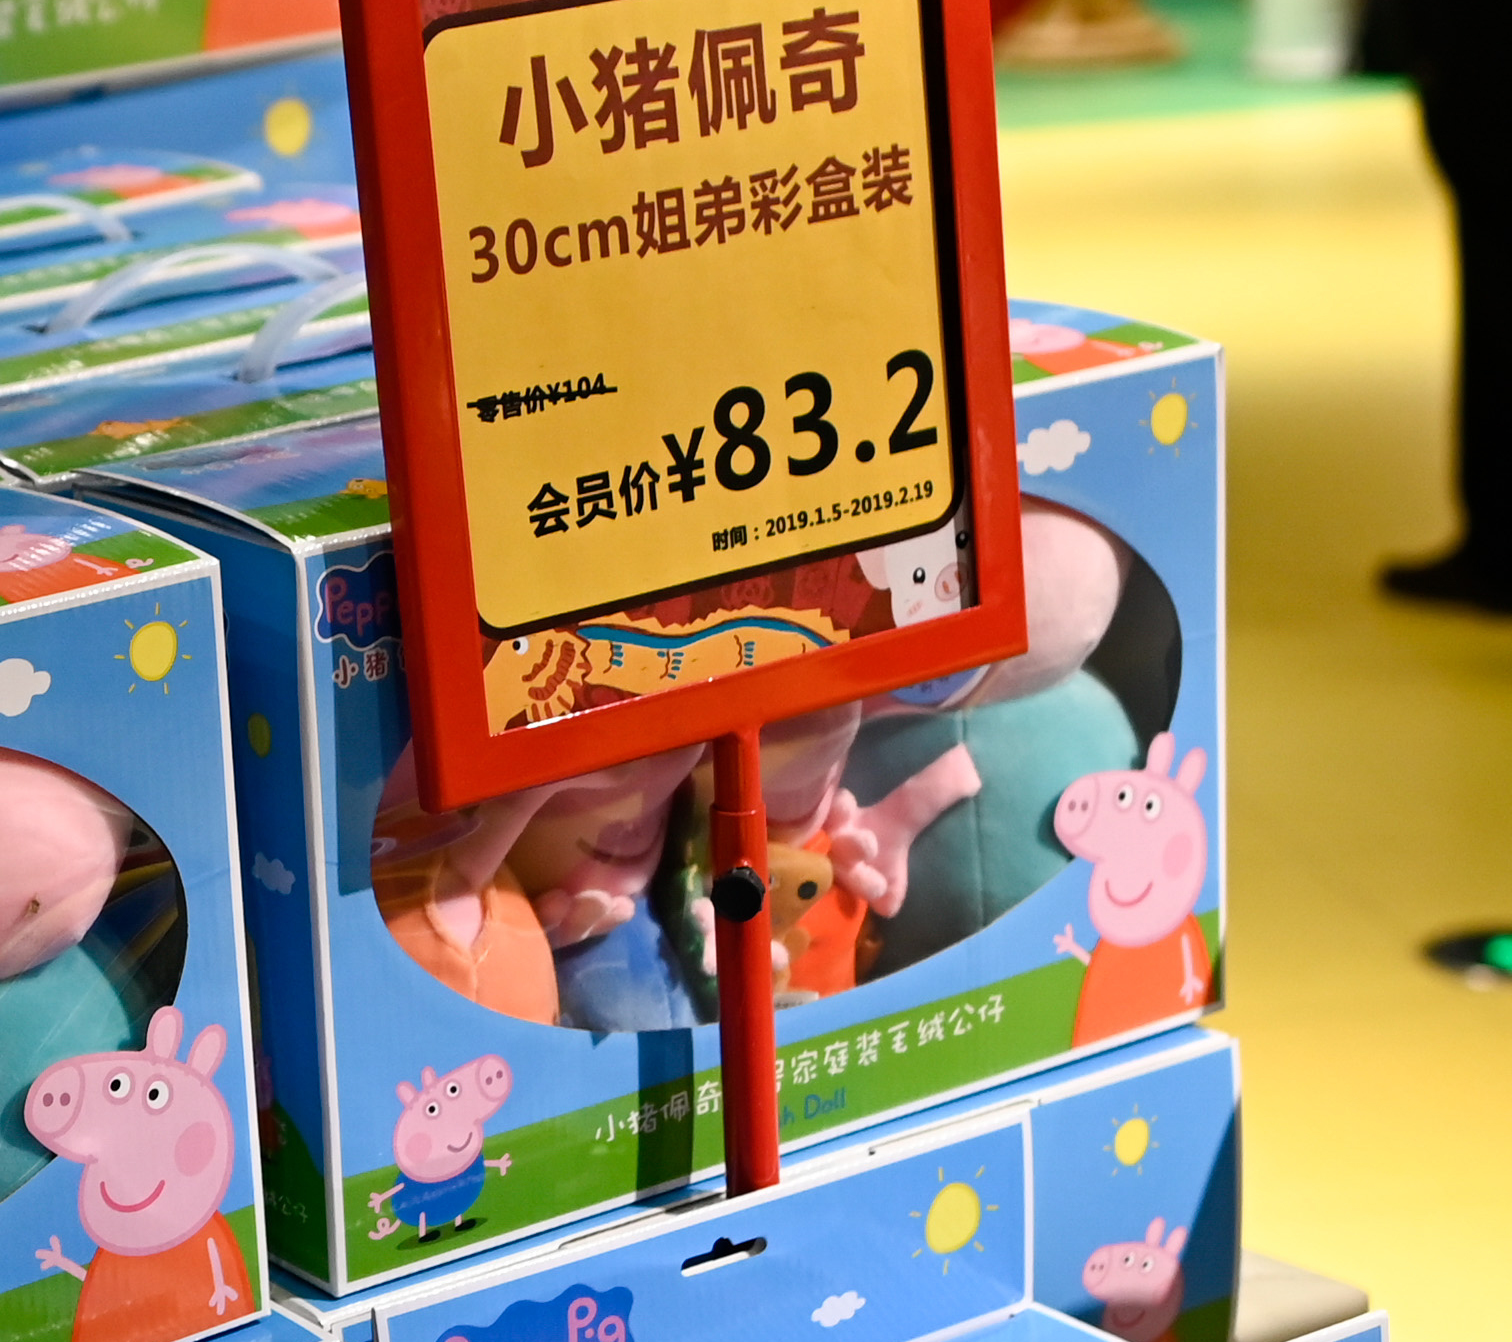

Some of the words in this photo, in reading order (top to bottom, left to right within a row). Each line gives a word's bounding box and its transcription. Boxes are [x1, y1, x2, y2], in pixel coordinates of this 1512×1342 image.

[498, 7, 867, 170] 小猪佩奇
[468, 143, 915, 285] 30cm姐弟彩盒装
[804, 1087, 847, 1119] Doll
